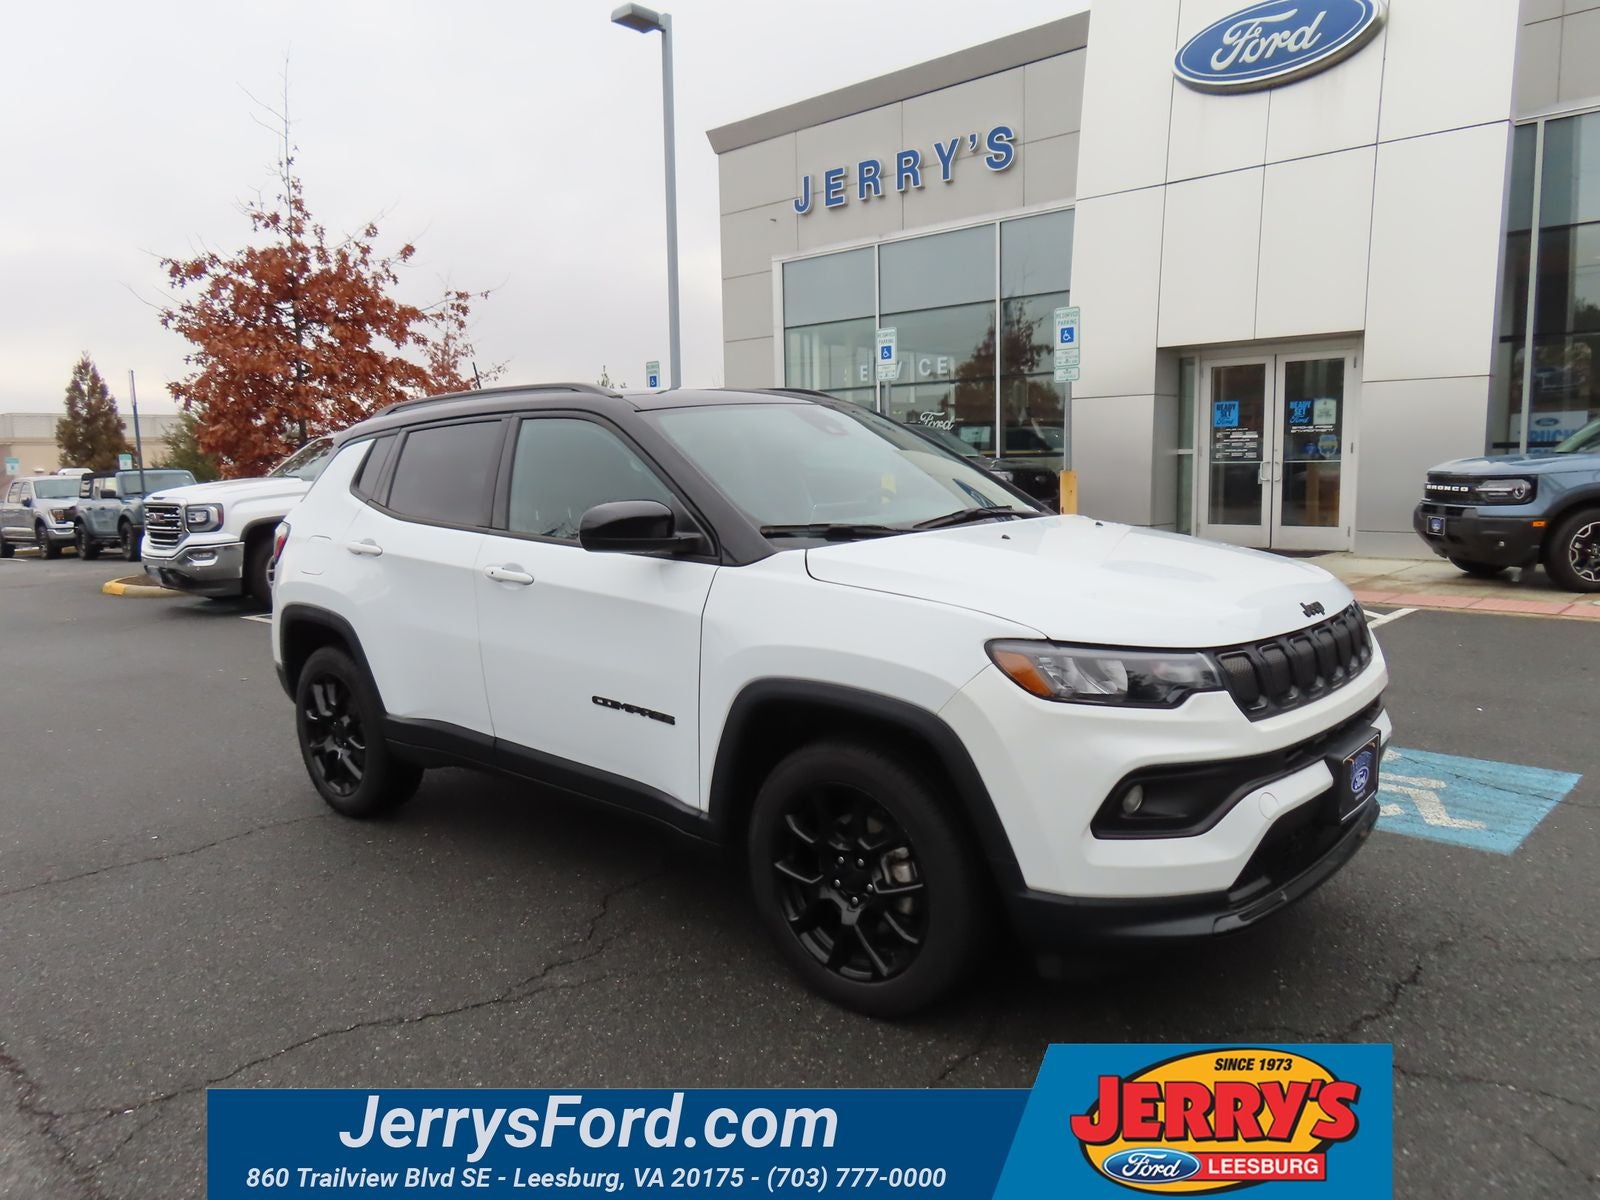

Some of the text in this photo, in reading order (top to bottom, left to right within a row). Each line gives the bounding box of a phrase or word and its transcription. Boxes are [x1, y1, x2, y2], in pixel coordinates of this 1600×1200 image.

[1210, 8, 1327, 71] Ford
[793, 125, 1015, 214] JERRY'S
[920, 411, 955, 431] Ford
[1426, 484, 1469, 492] BRONCO
